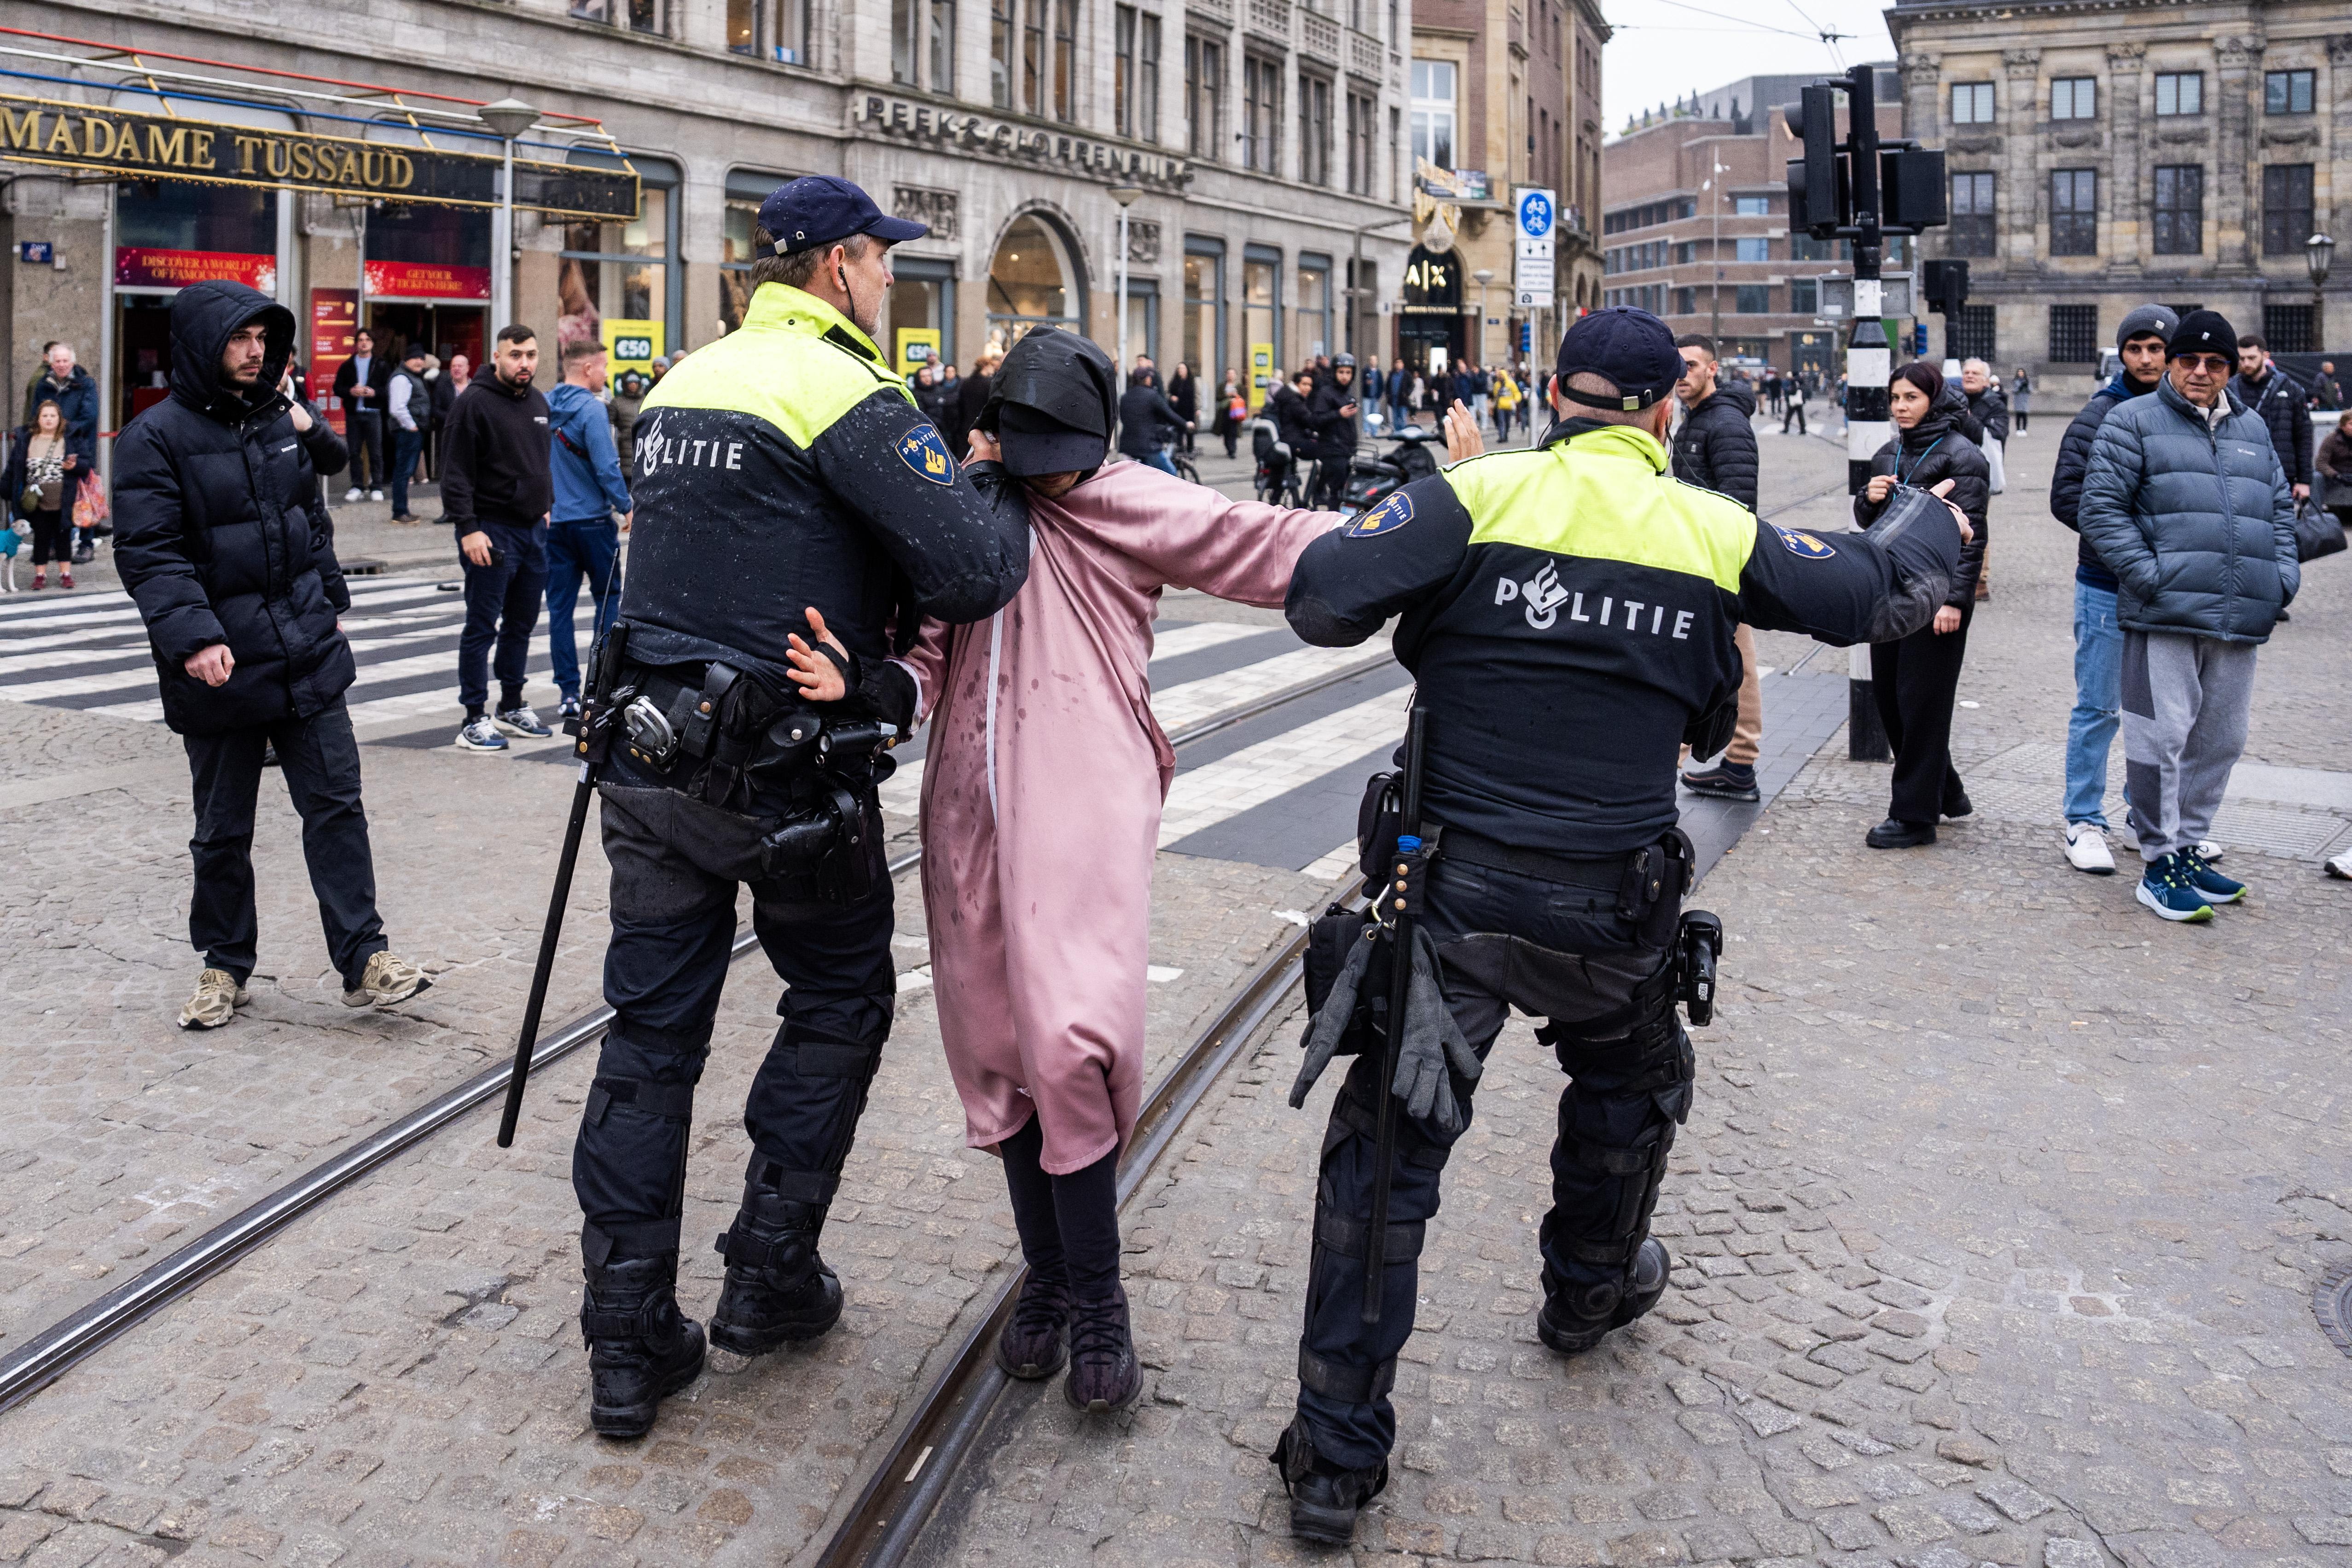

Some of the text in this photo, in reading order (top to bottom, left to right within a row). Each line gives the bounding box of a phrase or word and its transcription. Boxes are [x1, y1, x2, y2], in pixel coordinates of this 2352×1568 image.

[854, 95, 959, 141] PEEK
[0, 106, 414, 189] MADAME TUSSAUD
[616, 339, 650, 357] €50
[634, 432, 743, 476] POLITIE
[903, 430, 936, 455] POLITIE
[1386, 496, 1407, 520] POLITIE
[1494, 571, 1695, 639] POLITIE
